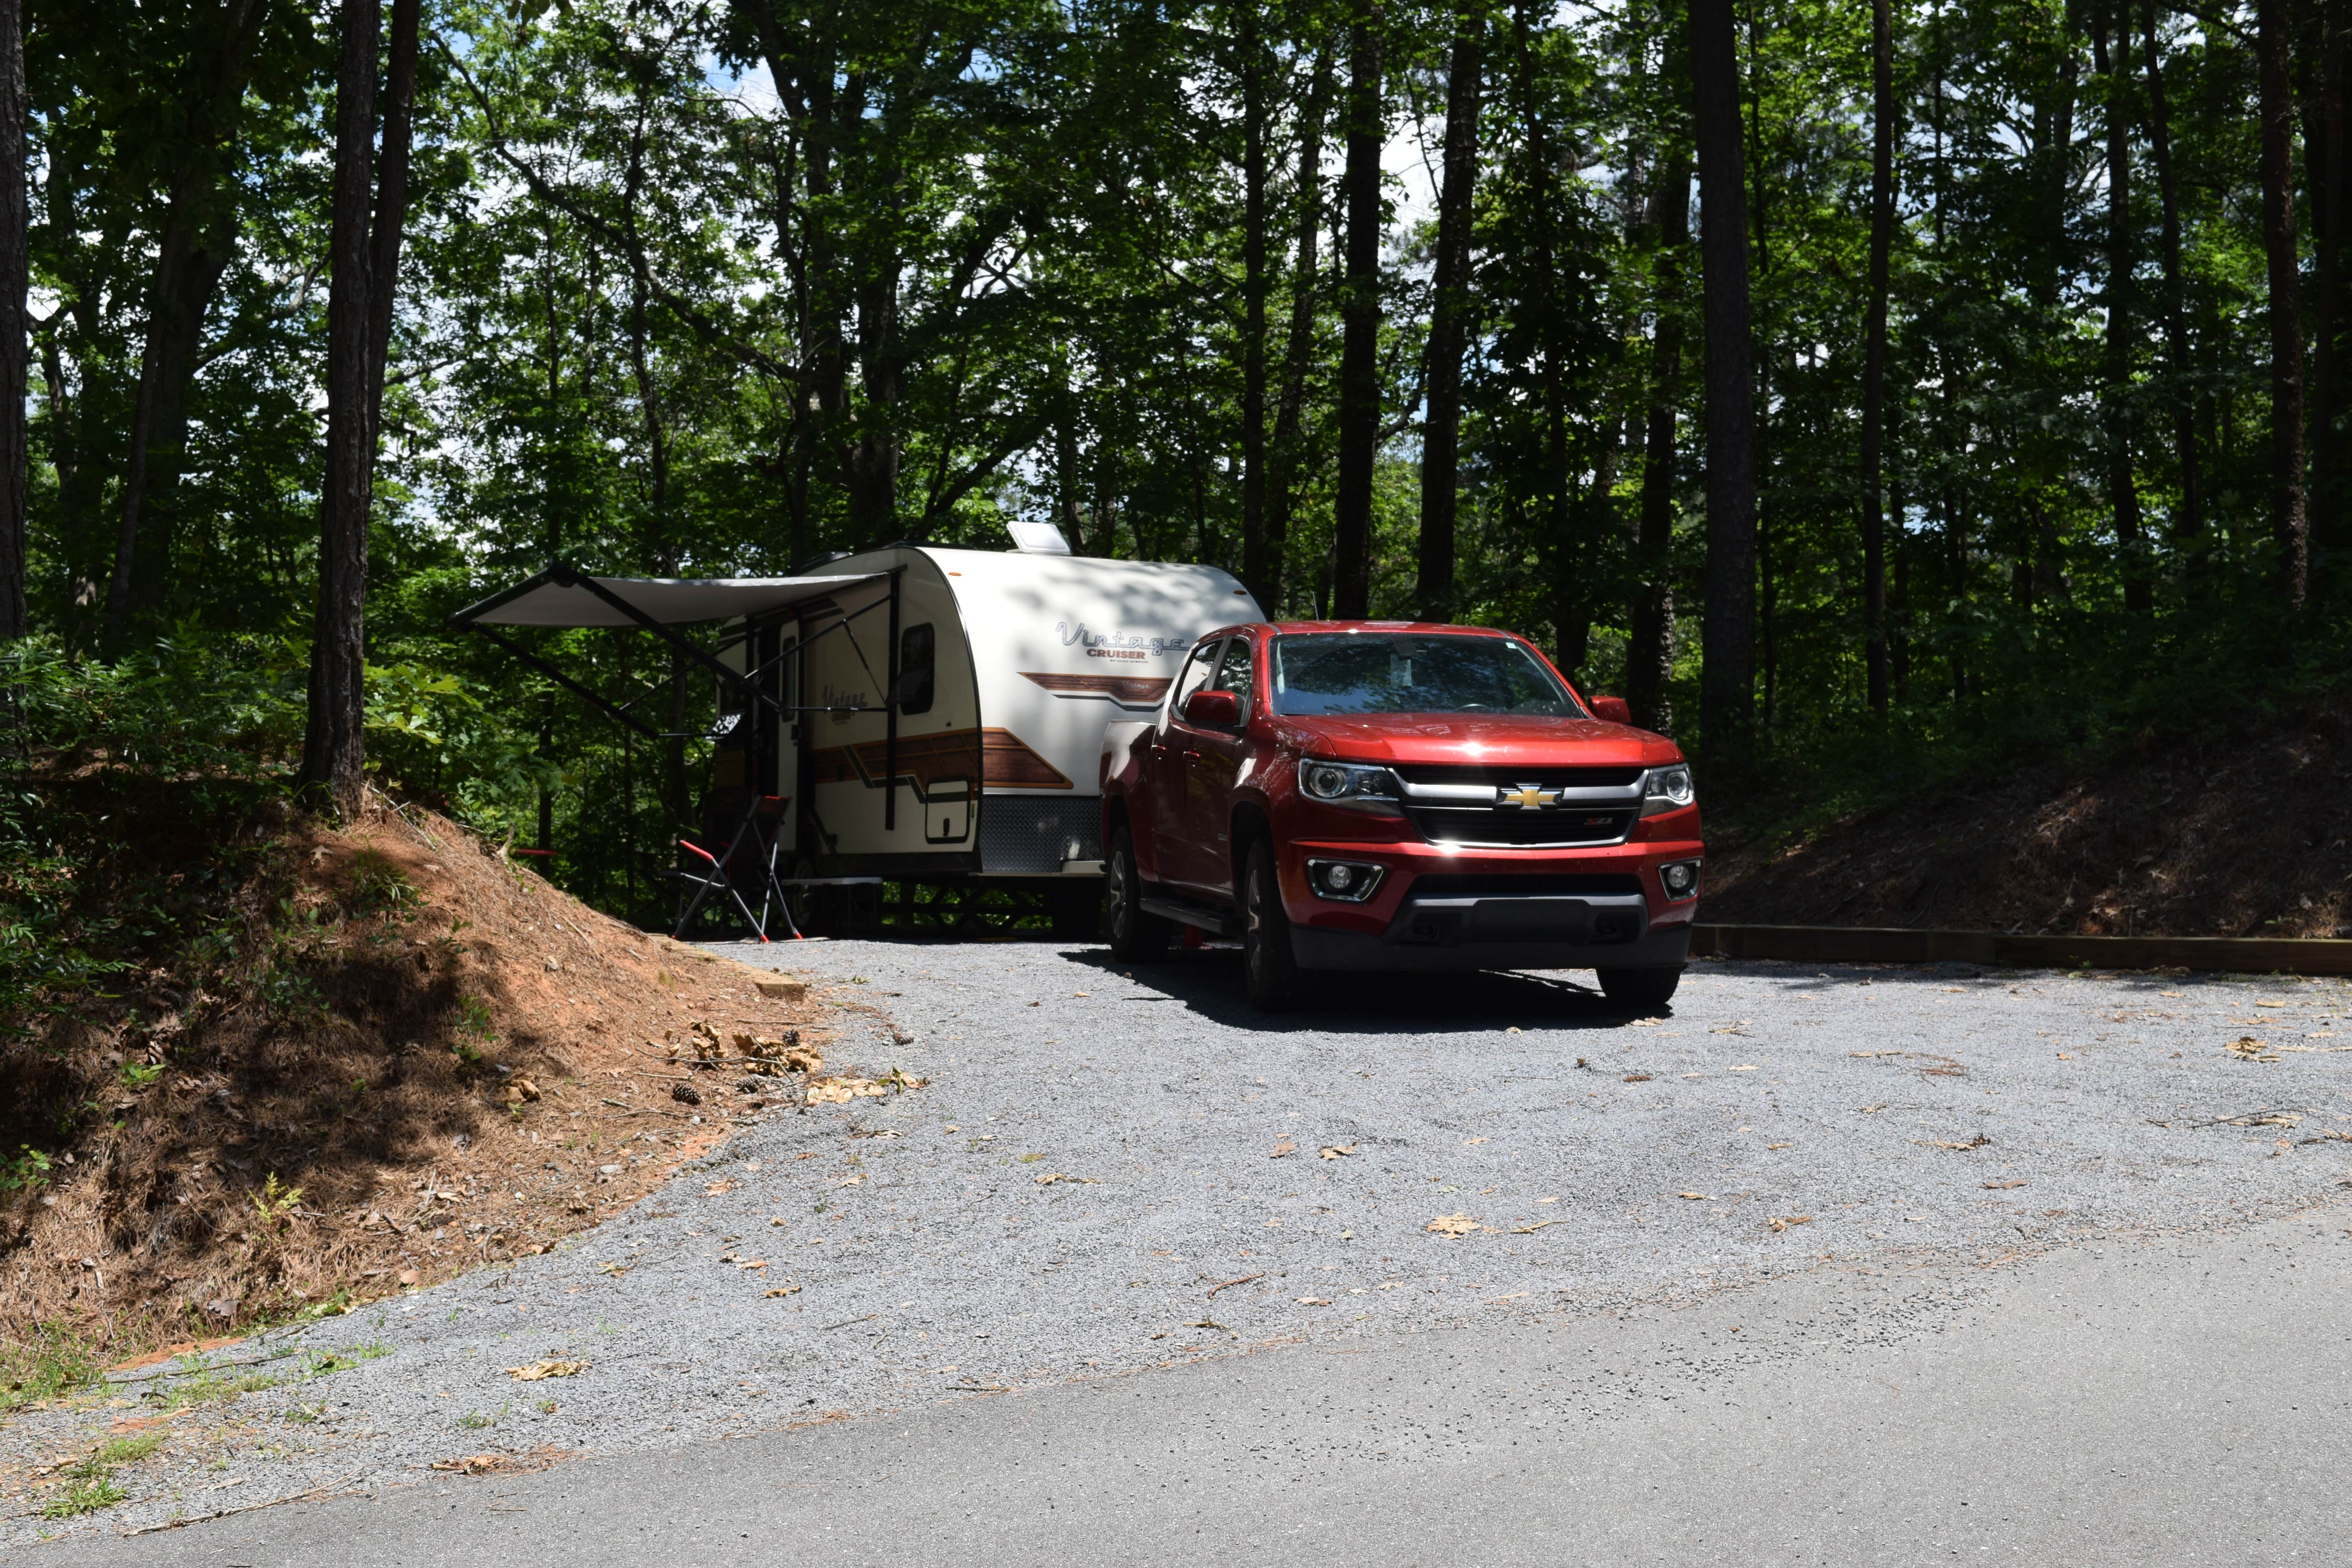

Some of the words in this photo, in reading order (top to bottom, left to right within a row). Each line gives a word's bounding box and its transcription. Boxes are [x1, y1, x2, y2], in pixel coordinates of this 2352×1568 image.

[1055, 621, 1190, 656] Vintage
[1086, 648, 1145, 659] CRUISER
[822, 684, 868, 716] Vintage
